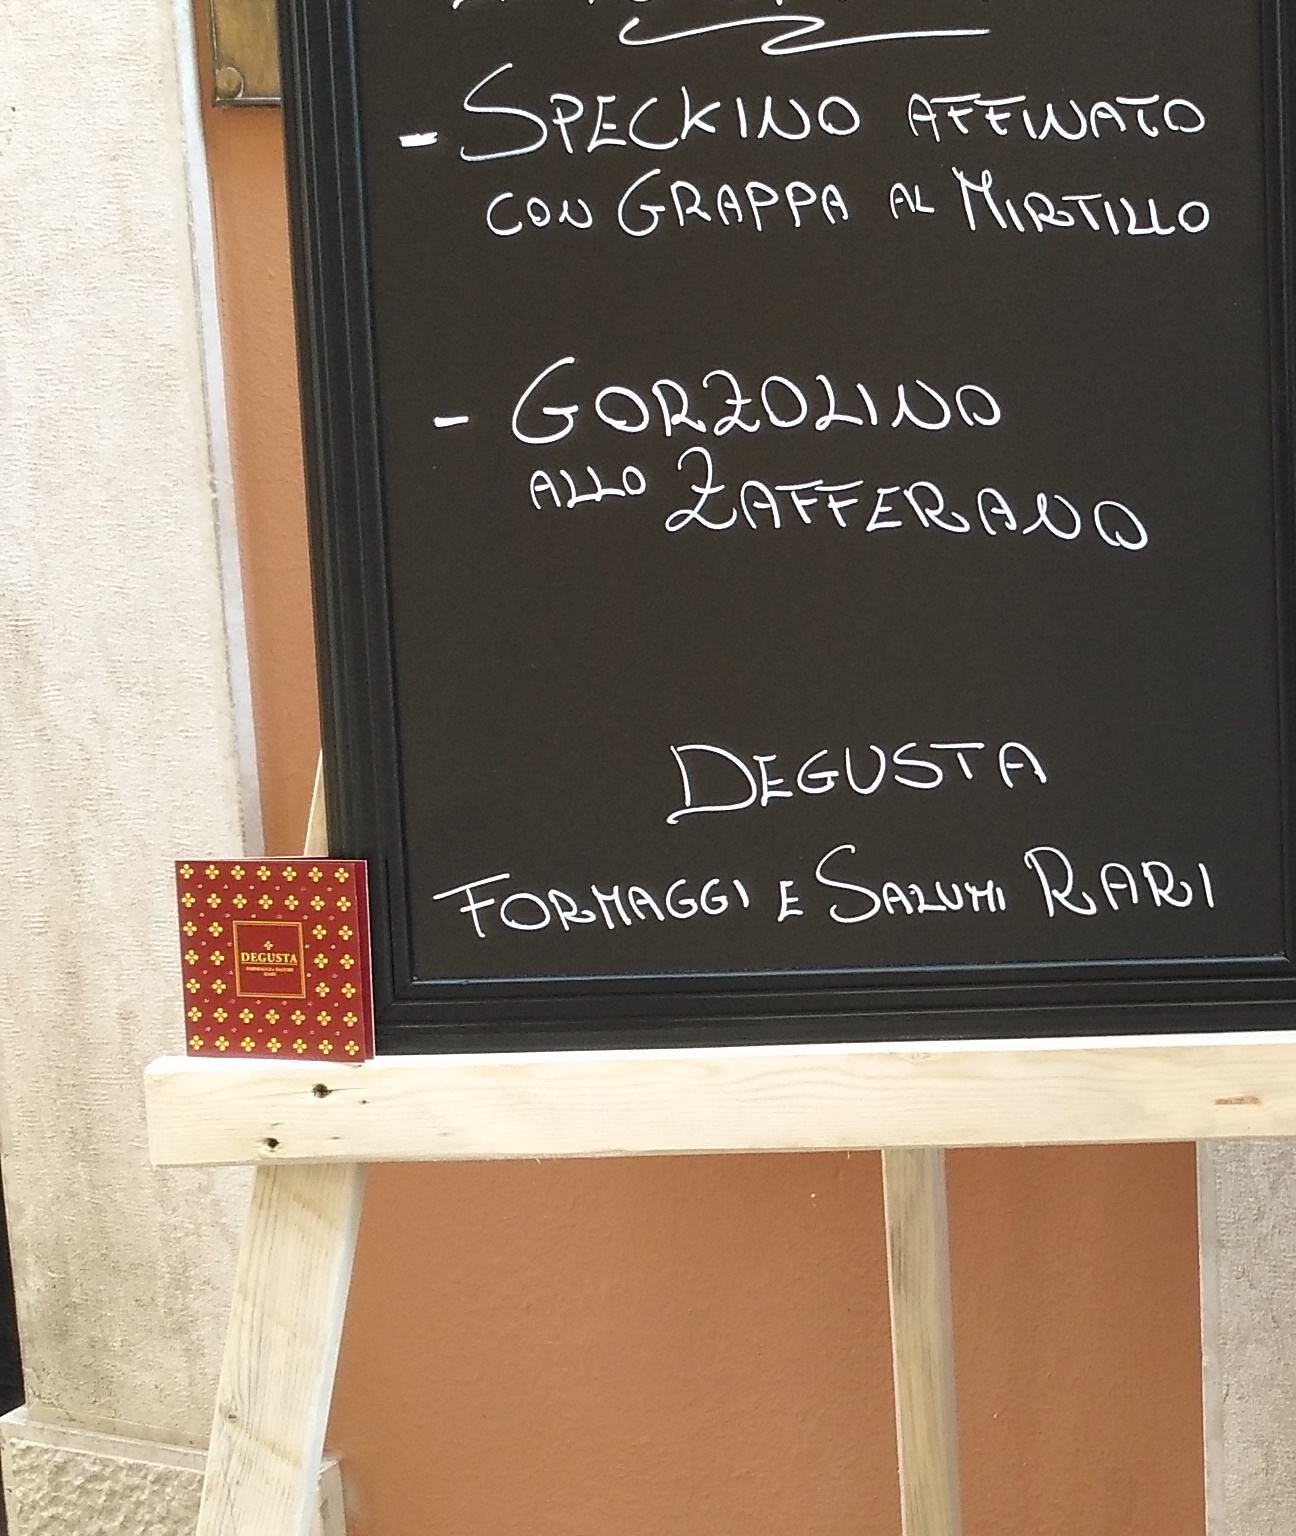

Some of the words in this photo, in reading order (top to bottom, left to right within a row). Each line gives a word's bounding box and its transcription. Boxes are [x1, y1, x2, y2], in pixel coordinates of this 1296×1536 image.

[460, 63, 860, 161] SPECKINO
[908, 93, 1205, 142] AFFINATO
[487, 192, 592, 235] CON
[618, 169, 848, 236] GRAPPA
[890, 183, 934, 219] AL
[952, 167, 1209, 235] MIRTILLO
[512, 357, 1001, 444] GORZOLINO
[530, 466, 646, 509] ALLO
[665, 447, 1148, 550] ZAFFERANO
[667, 742, 1046, 824] DEGUSTA
[433, 873, 749, 937] FORMAGGI
[778, 881, 803, 921] E
[816, 845, 1006, 923] SALUMI
[1024, 847, 1214, 917] RARI
[241, 952, 298, 963] DEGUSTA
